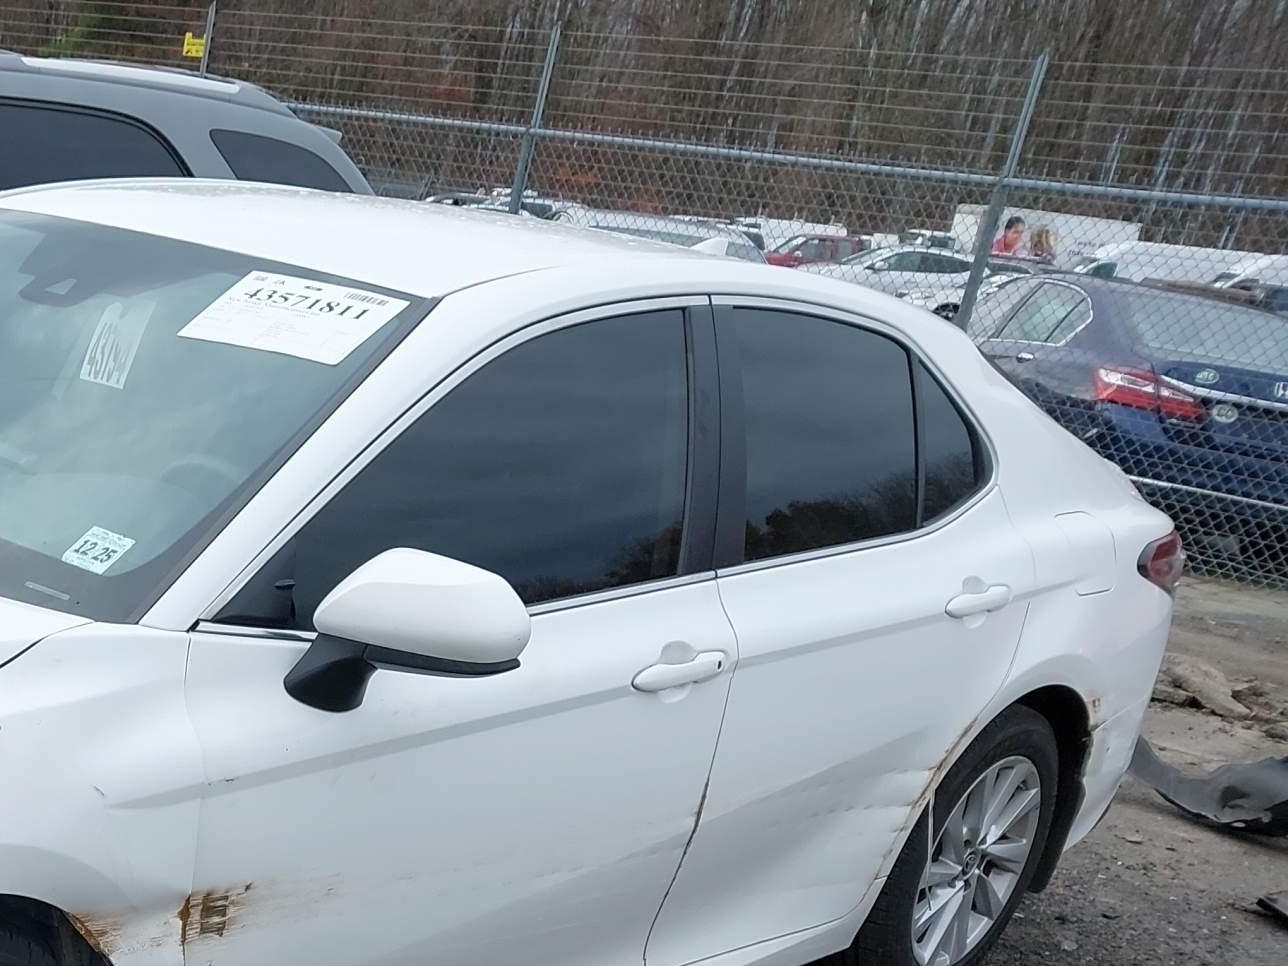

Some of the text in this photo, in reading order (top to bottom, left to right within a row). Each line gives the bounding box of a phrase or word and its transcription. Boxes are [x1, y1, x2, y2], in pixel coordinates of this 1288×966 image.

[244, 287, 369, 320] 43571811
[74, 539, 98, 556] 12
[91, 546, 118, 564] 25
